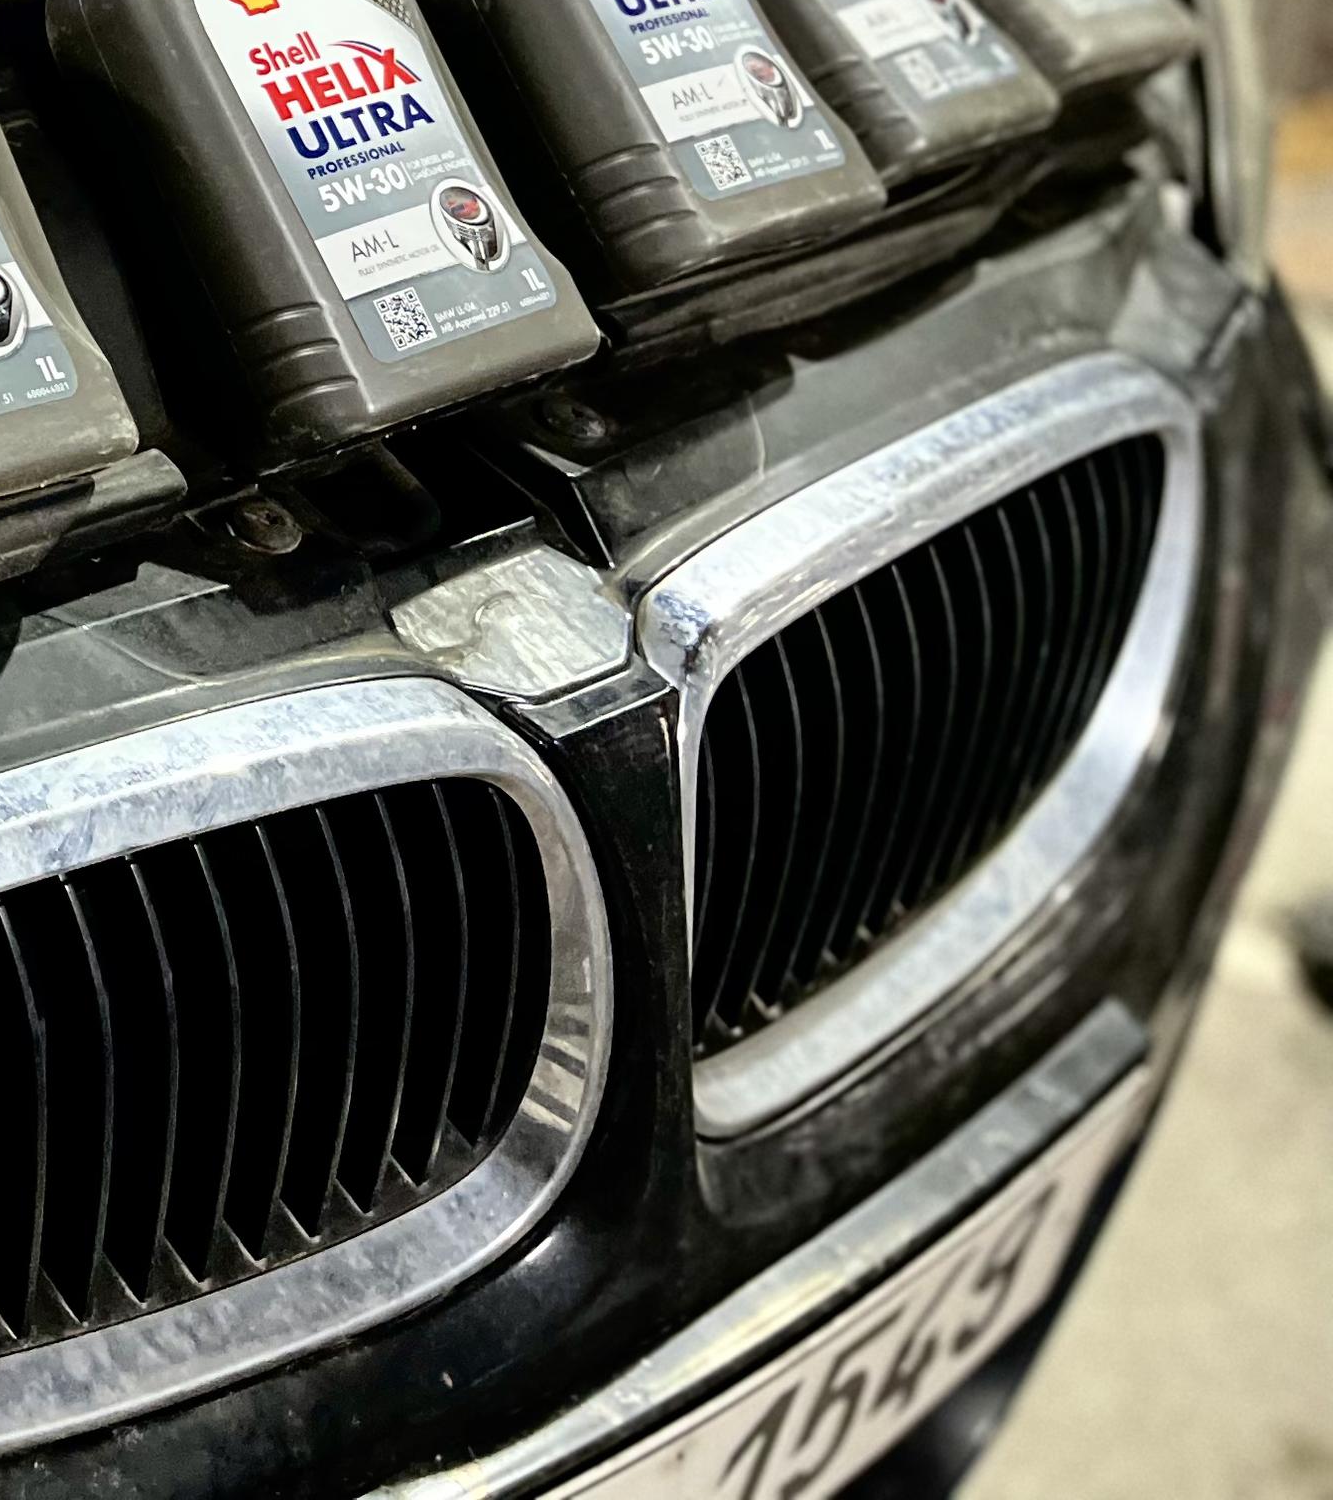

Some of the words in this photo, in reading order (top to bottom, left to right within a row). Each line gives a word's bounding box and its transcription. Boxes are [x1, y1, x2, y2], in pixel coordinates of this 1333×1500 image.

[629, 7, 710, 35] PROFESSIONAL
[248, 30, 321, 77] Shell
[639, 25, 714, 65] 5W-30
[261, 47, 422, 122] HELIX
[672, 82, 714, 110] AM-L
[286, 93, 436, 160] ULTRA
[307, 141, 406, 180] PROFESSIONAL
[318, 162, 407, 213] 5W-30
[351, 230, 400, 262] AM-L
[521, 268, 546, 292] 1L
[434, 307, 455, 324] BMW
[35, 356, 66, 383] 1L
